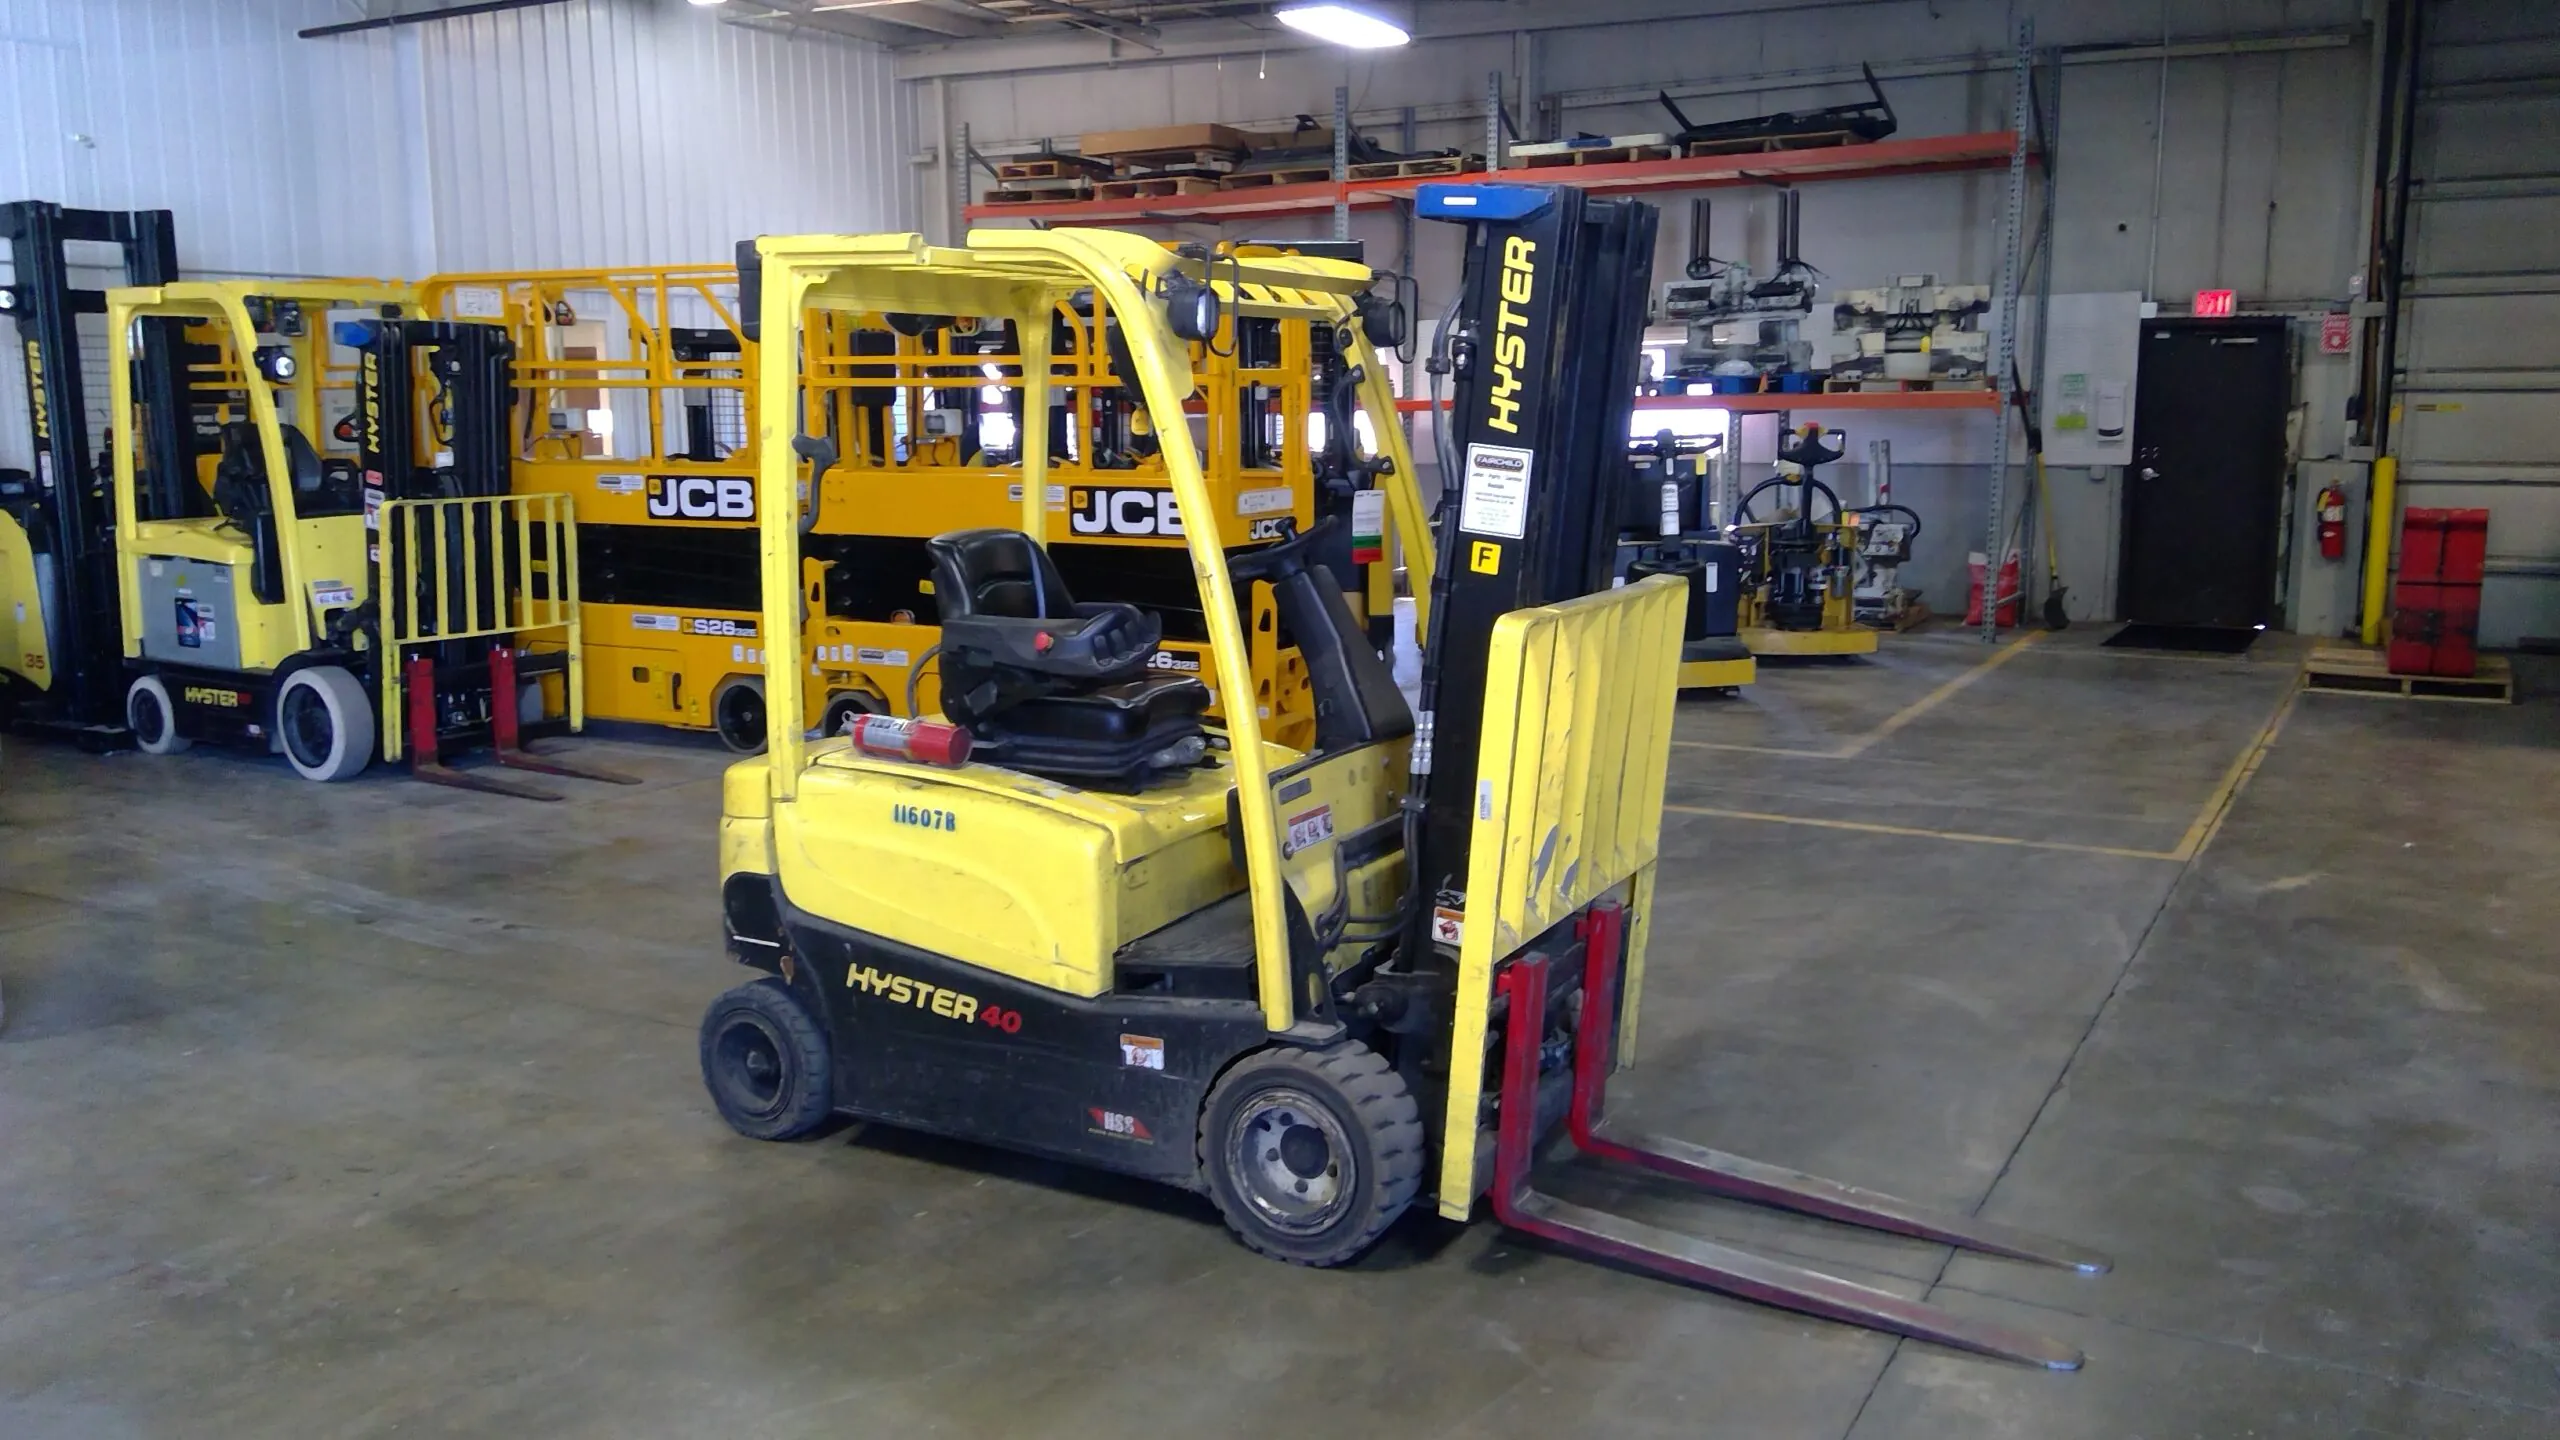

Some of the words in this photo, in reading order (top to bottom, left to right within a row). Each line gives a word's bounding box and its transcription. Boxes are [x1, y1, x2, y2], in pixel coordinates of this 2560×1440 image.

[1488, 235, 1536, 434] HYSTER
[364, 352, 381, 453] HYSTER
[649, 478, 754, 518] JCB
[1478, 547, 1493, 567] F
[25, 653, 45, 670] 35
[185, 686, 238, 707] HYSTER
[846, 962, 978, 1024] HYSTER
[980, 1005, 1022, 1033] 40
